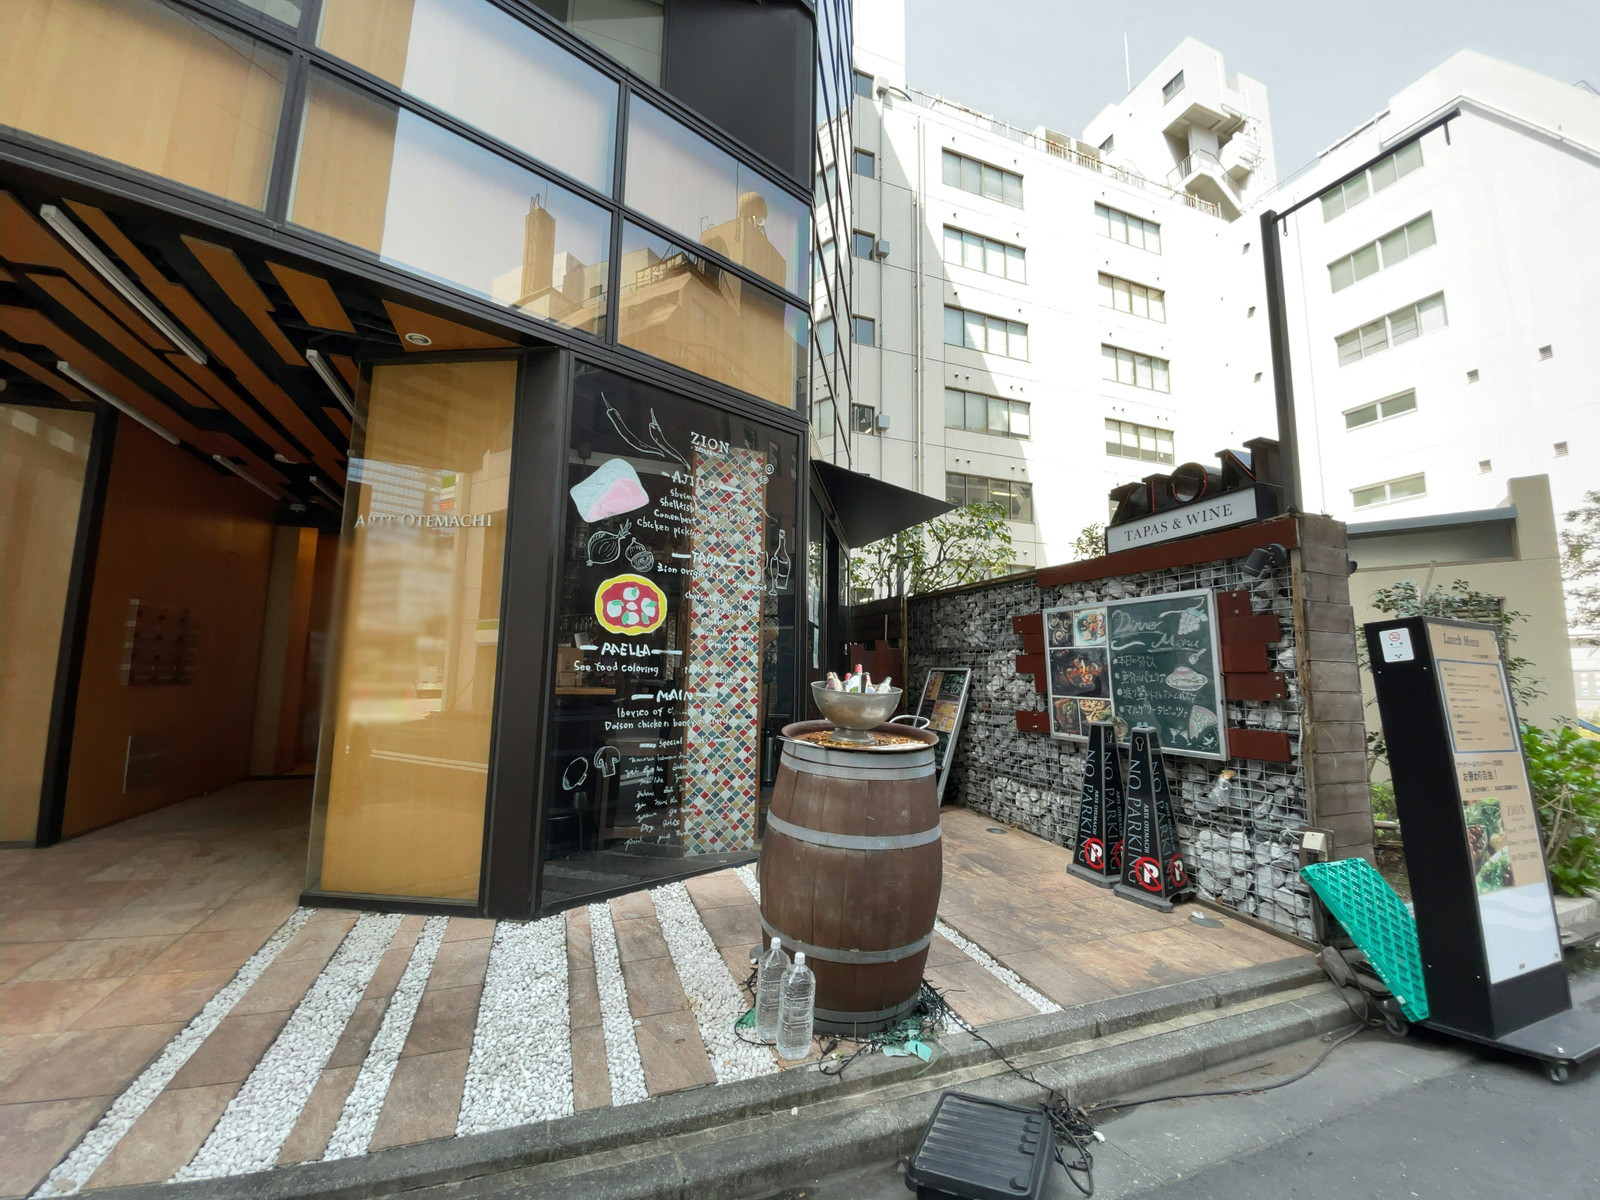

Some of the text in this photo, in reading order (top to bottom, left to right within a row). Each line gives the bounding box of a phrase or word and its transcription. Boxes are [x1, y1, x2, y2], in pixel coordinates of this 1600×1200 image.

[691, 431, 730, 454] ZION
[1124, 503, 1233, 542] TAPAS & WINE
[1111, 609, 1163, 633] Dinner
[1151, 633, 1200, 649] Menu
[1443, 632, 1480, 648] Lunch Menu
[601, 642, 651, 658] PAELLA
[595, 660, 618, 672] food
[621, 661, 659, 677] coloring
[656, 689, 693, 703] MAIN
[616, 707, 649, 719] Iberico
[652, 706, 663, 718] of
[637, 717, 669, 730] chicken
[1085, 749, 1096, 778] NO
[1128, 759, 1142, 790] NO
